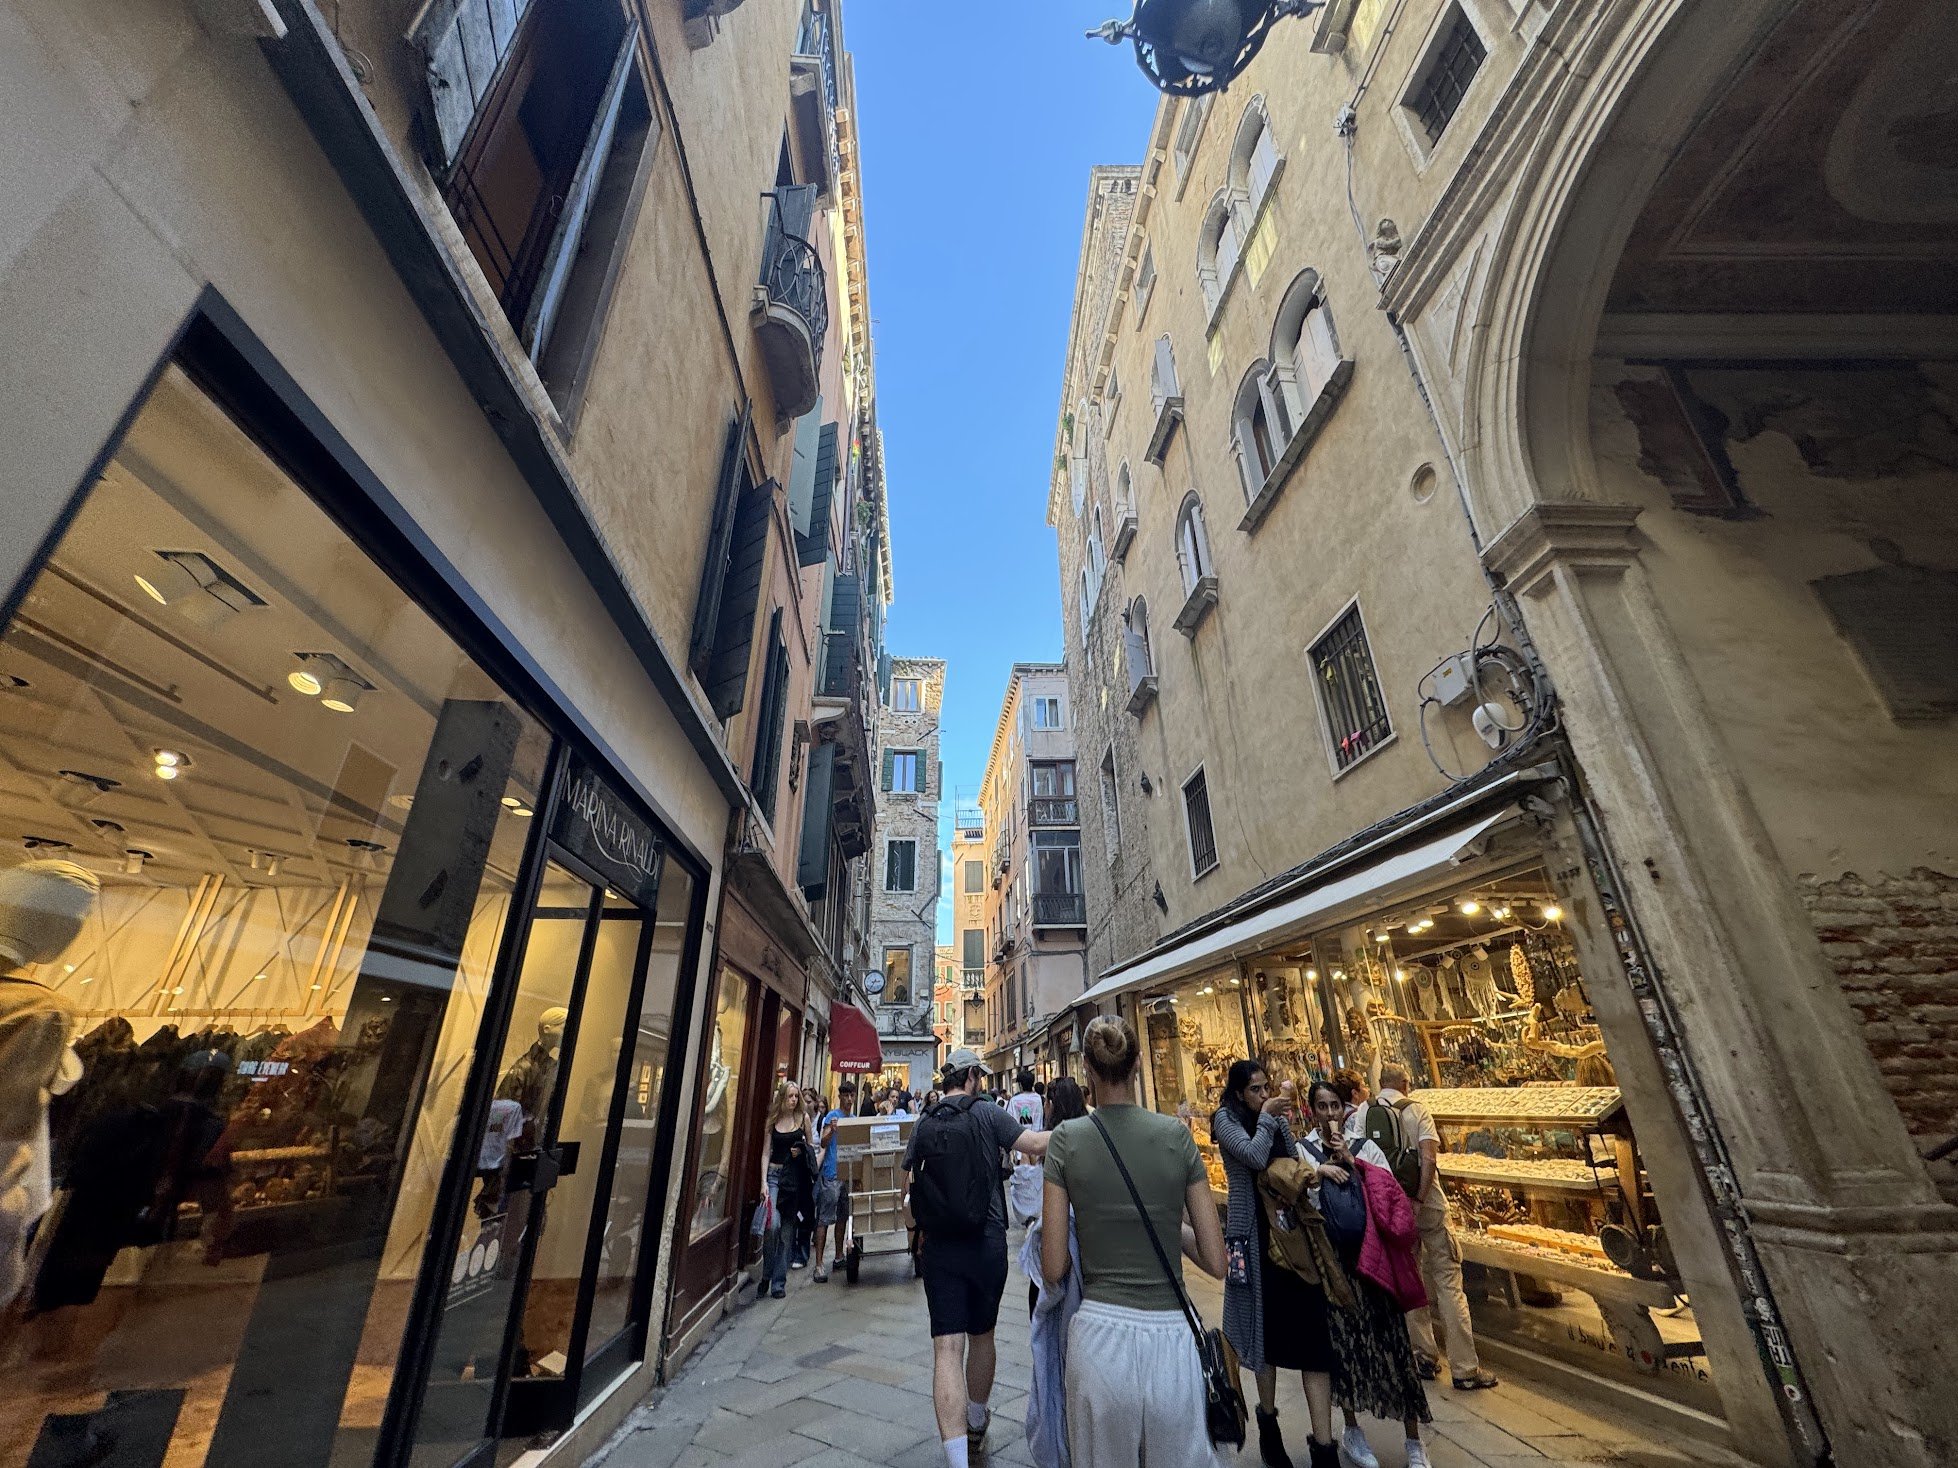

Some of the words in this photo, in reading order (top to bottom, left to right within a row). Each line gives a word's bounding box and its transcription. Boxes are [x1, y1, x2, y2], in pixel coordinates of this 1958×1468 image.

[618, 821, 662, 883] RINALDI
[883, 1048, 929, 1057] NYBLACK
[839, 1060, 871, 1069] COIFFEUR
